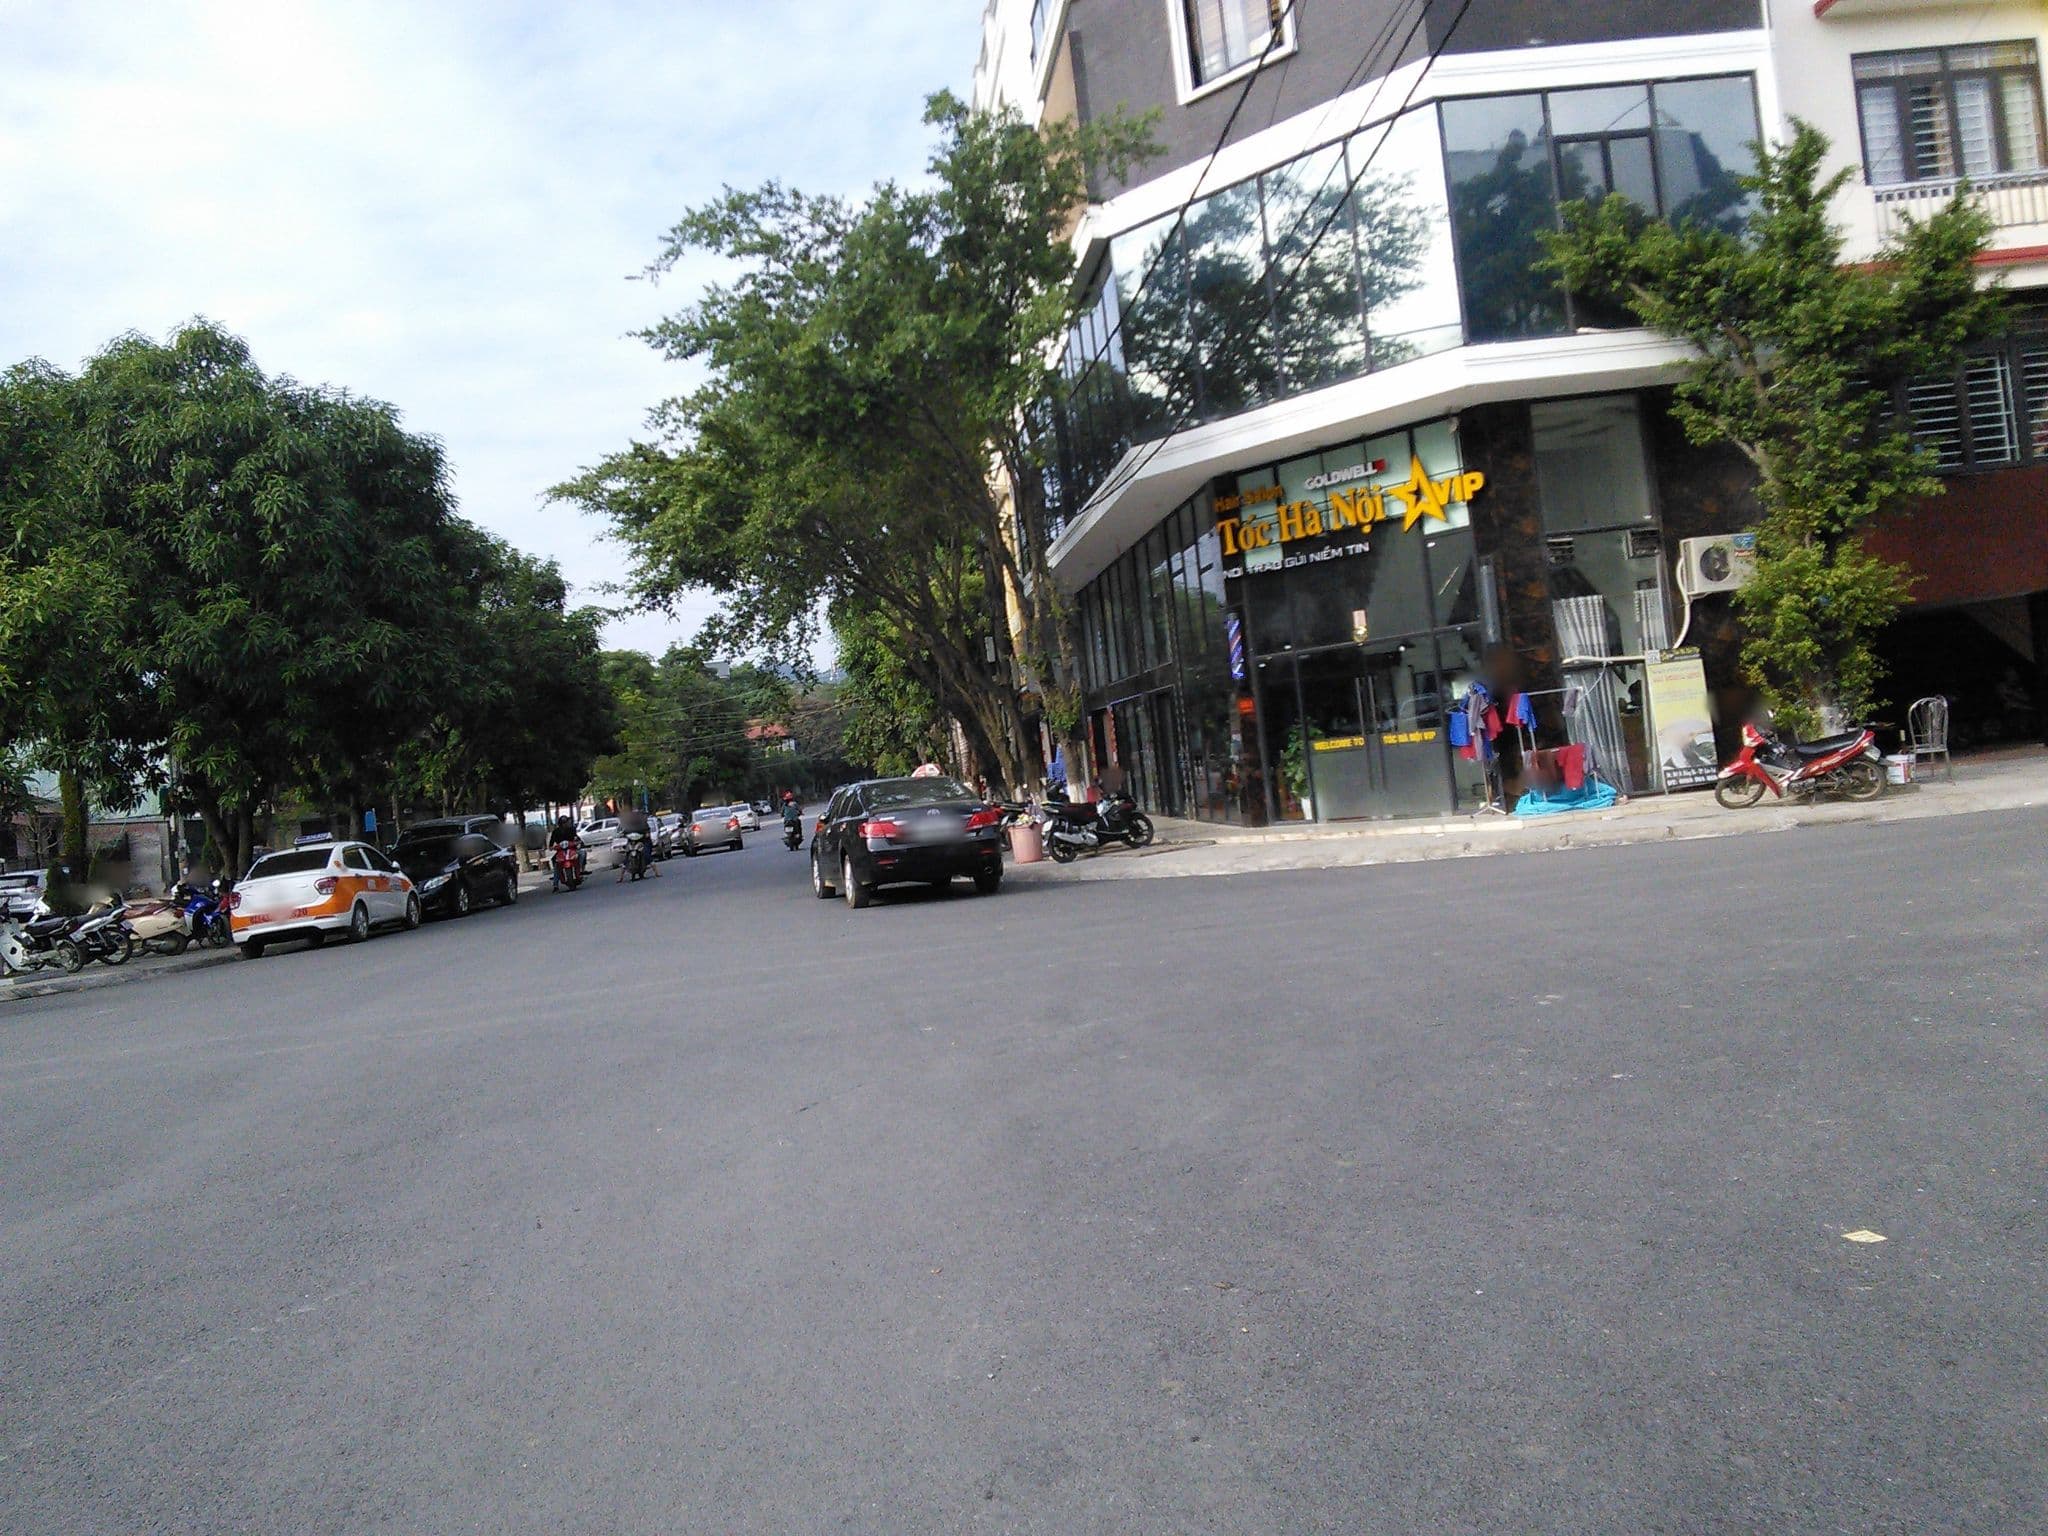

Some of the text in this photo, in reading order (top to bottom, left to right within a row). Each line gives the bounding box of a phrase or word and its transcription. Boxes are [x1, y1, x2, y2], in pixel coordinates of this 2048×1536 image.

[1304, 461, 1378, 490] GOLDWELL
[1215, 471, 1485, 556] Tóc Hà Nội VIP
[1345, 541, 1370, 555] TIN
